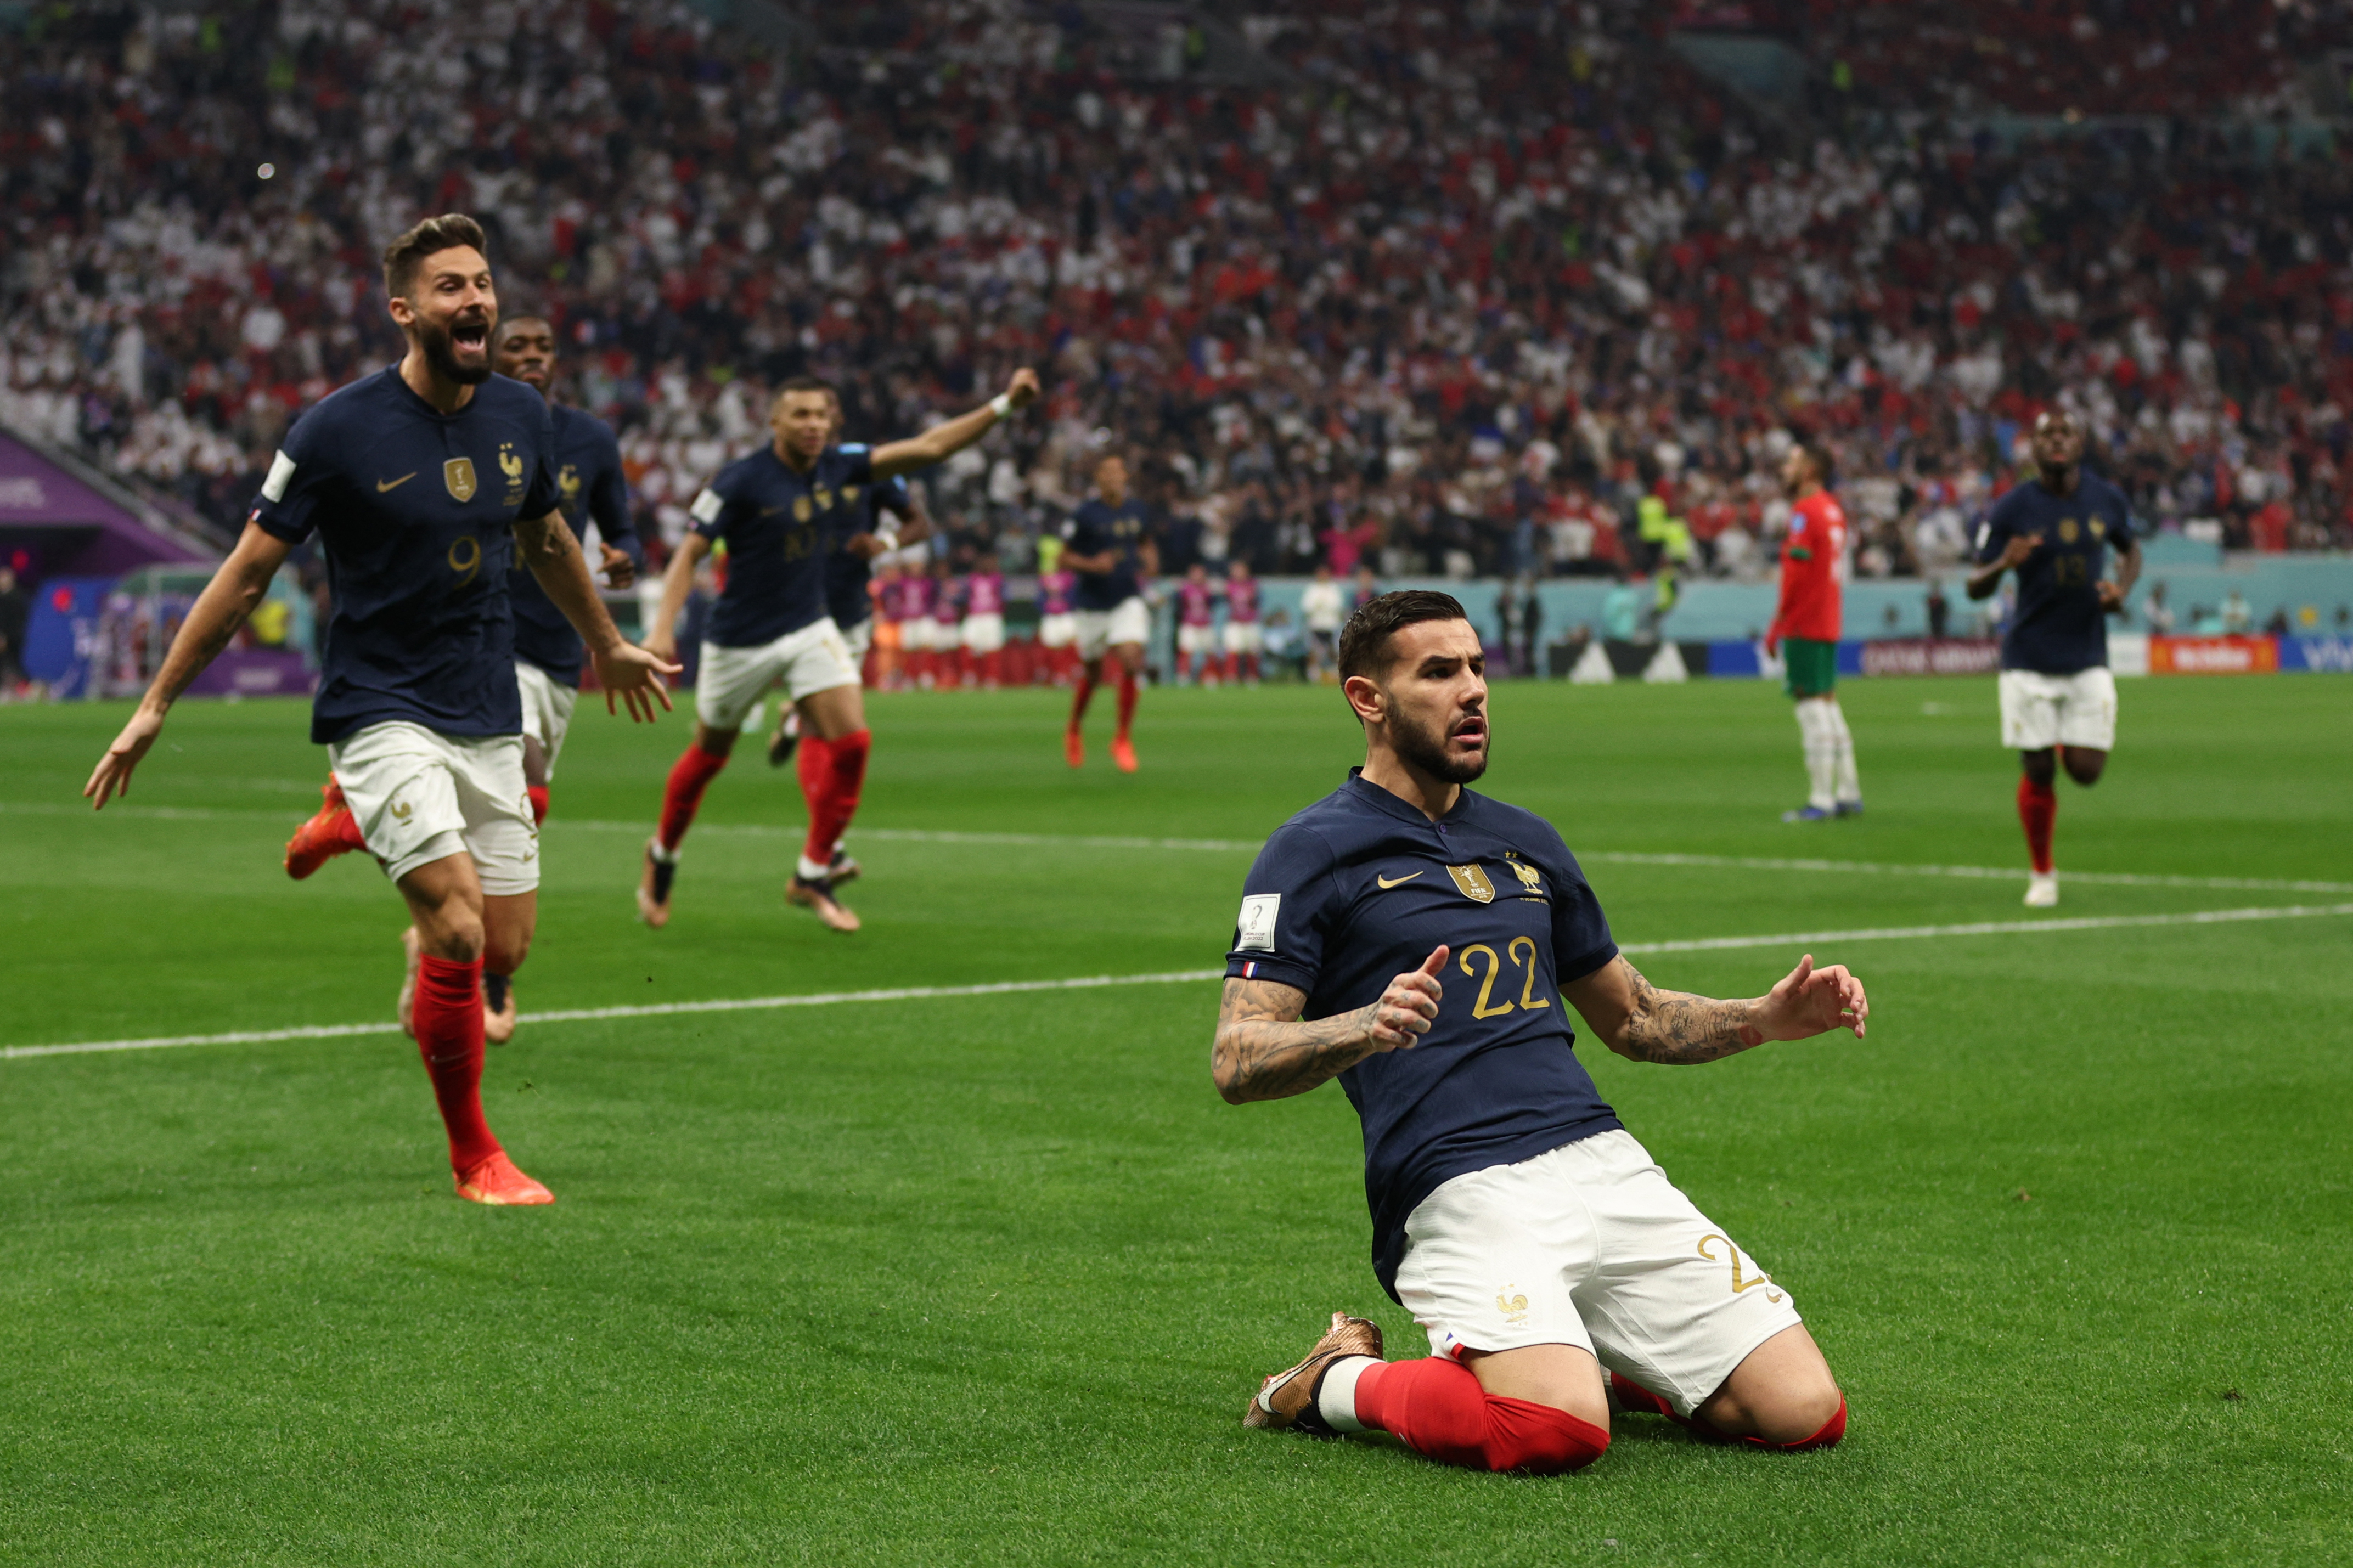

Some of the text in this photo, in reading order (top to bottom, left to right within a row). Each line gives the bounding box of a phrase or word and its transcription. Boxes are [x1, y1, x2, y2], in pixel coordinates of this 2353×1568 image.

[448, 534, 481, 590] 9
[1459, 935, 1550, 1019] 22
[1697, 1234, 1772, 1294] 2
